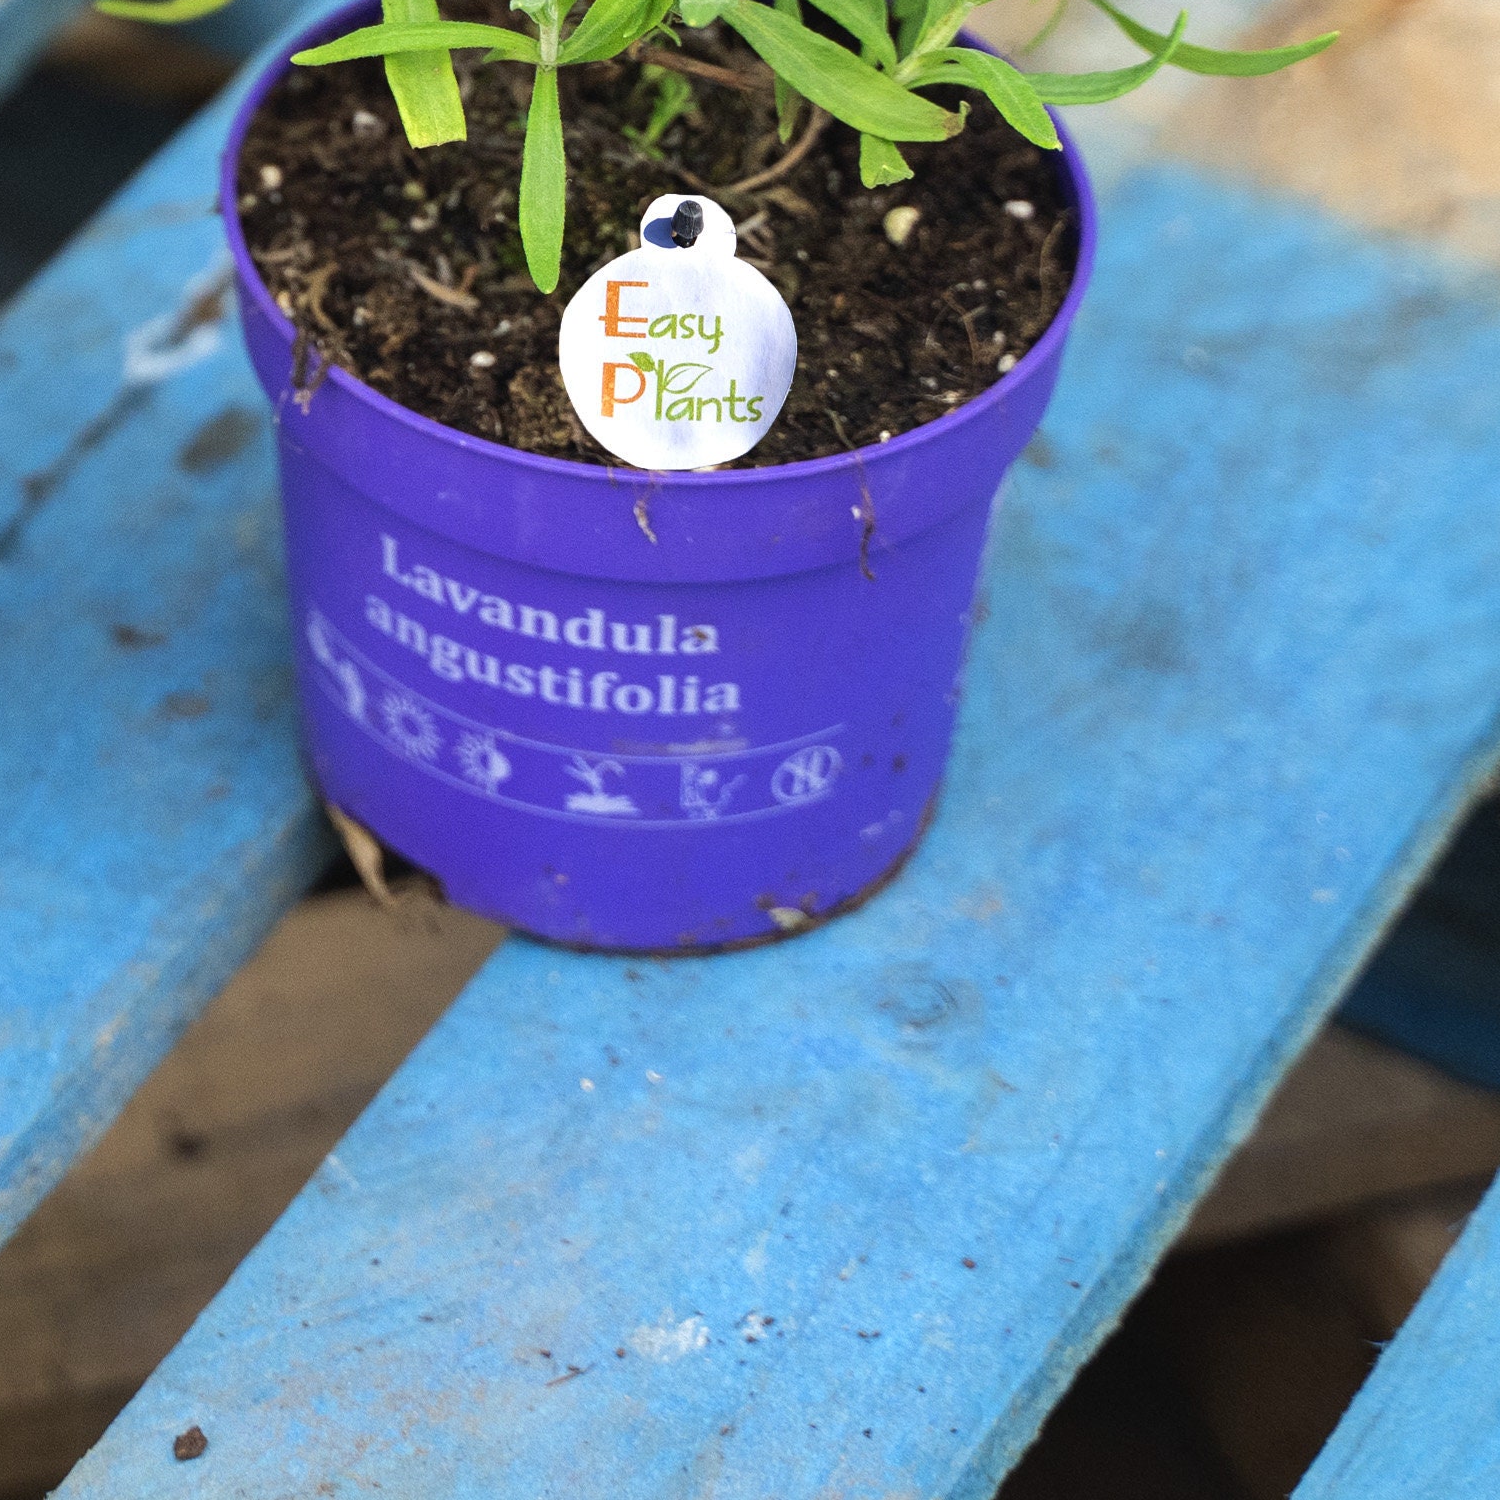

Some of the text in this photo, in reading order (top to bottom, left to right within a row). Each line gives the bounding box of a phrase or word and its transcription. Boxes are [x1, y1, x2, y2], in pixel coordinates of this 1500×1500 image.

[598, 280, 724, 354] Easy
[601, 359, 764, 422] Plants
[379, 532, 720, 655] Lavandula
[365, 595, 740, 715] angustifolia
